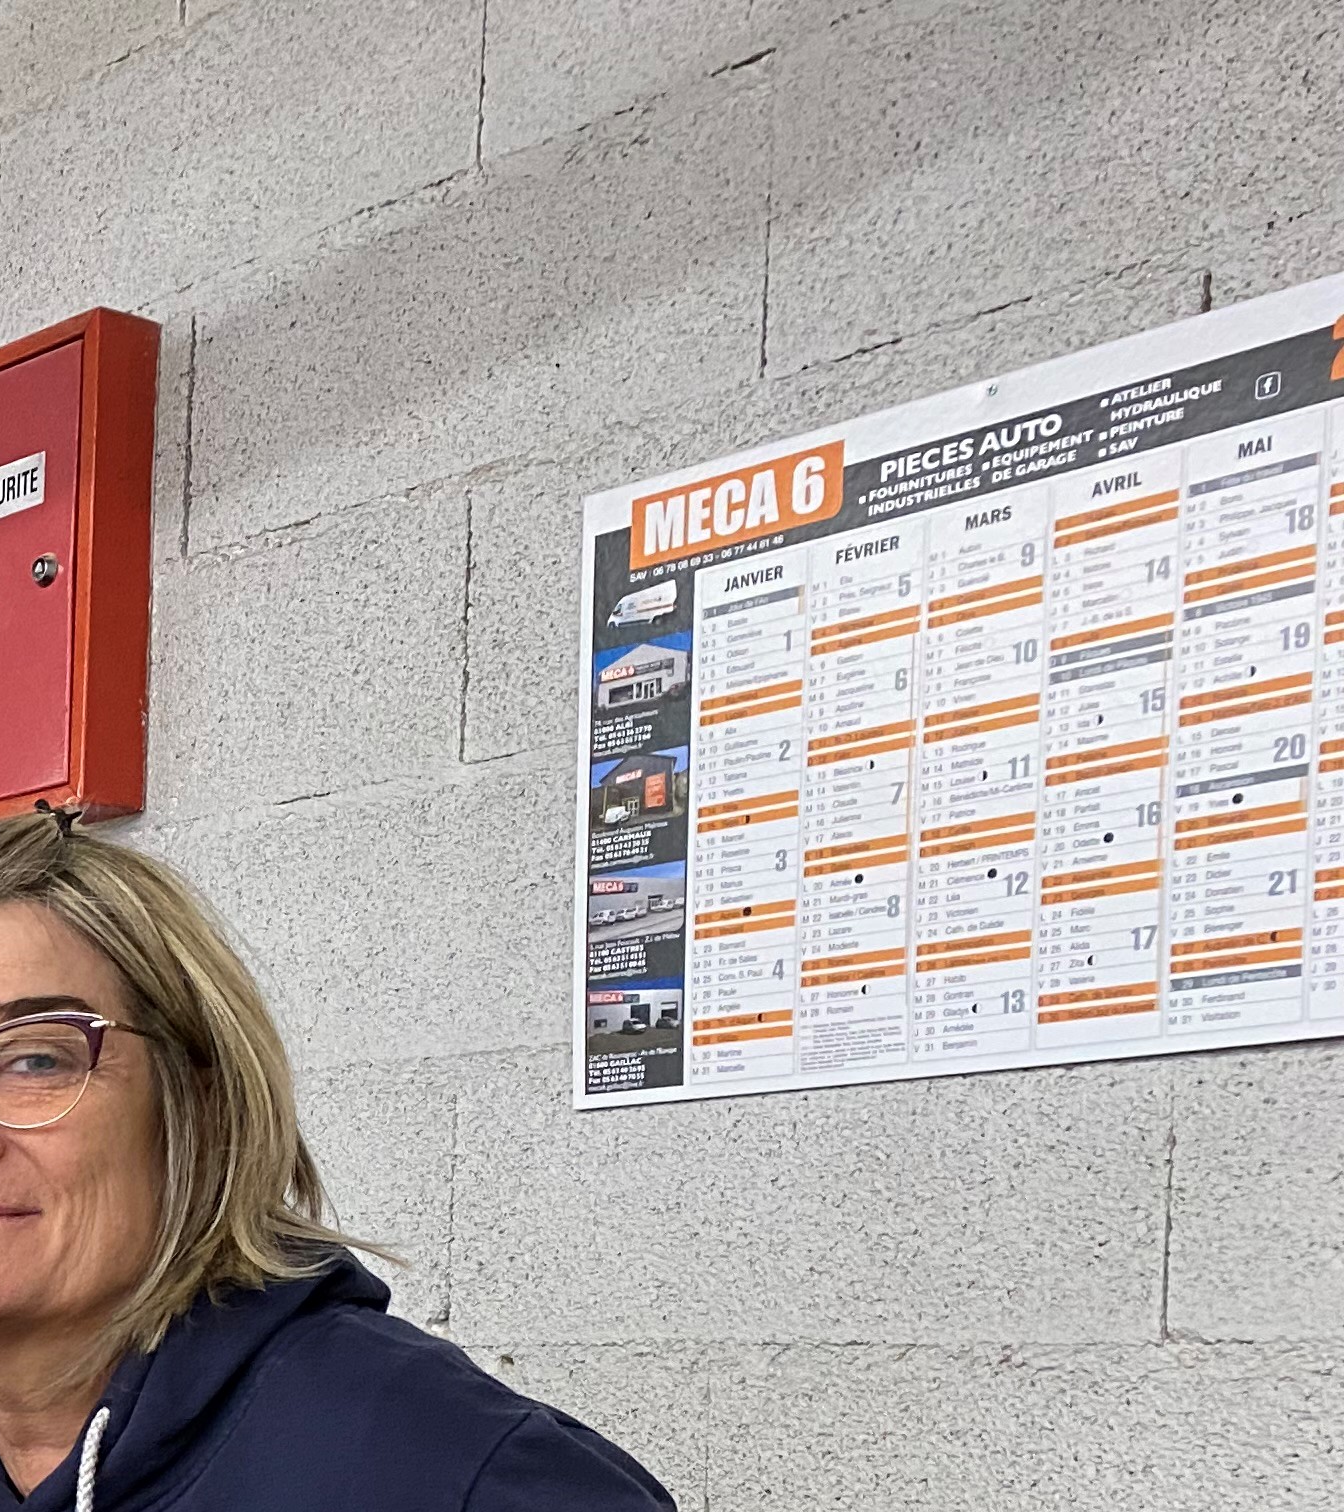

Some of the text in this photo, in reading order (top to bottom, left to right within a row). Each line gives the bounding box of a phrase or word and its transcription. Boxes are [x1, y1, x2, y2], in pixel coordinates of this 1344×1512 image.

[1111, 379, 1223, 422] HYDRAULIQUE
[1112, 378, 1172, 405] ATELIER
[1110, 408, 1185, 439] PEINTURE
[880, 413, 1062, 483] PIECES AUTO
[992, 430, 1095, 468] EQUIPEMENT
[1109, 437, 1139, 456] SAV
[1237, 435, 1273, 461] MAI
[992, 450, 1077, 484] DE GARAGE
[868, 476, 981, 517] INDUSTRIELLES
[869, 464, 973, 502] FOURNITURES
[1092, 472, 1143, 498] AVRIL
[643, 455, 825, 557] MECA 6
[964, 505, 1012, 531] MARS
[1284, 502, 1314, 535] 18
[835, 535, 900, 565] FÉVRIER
[1020, 541, 1034, 568] 9
[724, 565, 784, 592] JANVIER
[1144, 555, 1170, 583] 14
[898, 572, 911, 598] 5
[783, 629, 791, 652] 1
[1279, 620, 1310, 652] 19
[1012, 637, 1037, 666] 10
[894, 666, 907, 692] 6
[1139, 686, 1166, 715] 15
[778, 738, 790, 761] 2
[1273, 732, 1305, 763] 20
[1007, 754, 1029, 780] 11
[889, 780, 904, 805] 7
[1135, 800, 1162, 828] 16
[775, 848, 787, 872] 3
[1002, 870, 1029, 897] 12
[1268, 868, 1297, 896] 21
[886, 894, 900, 918] 8
[1130, 924, 1158, 951] 17
[772, 958, 784, 981] 4
[999, 988, 1025, 1014] 13
